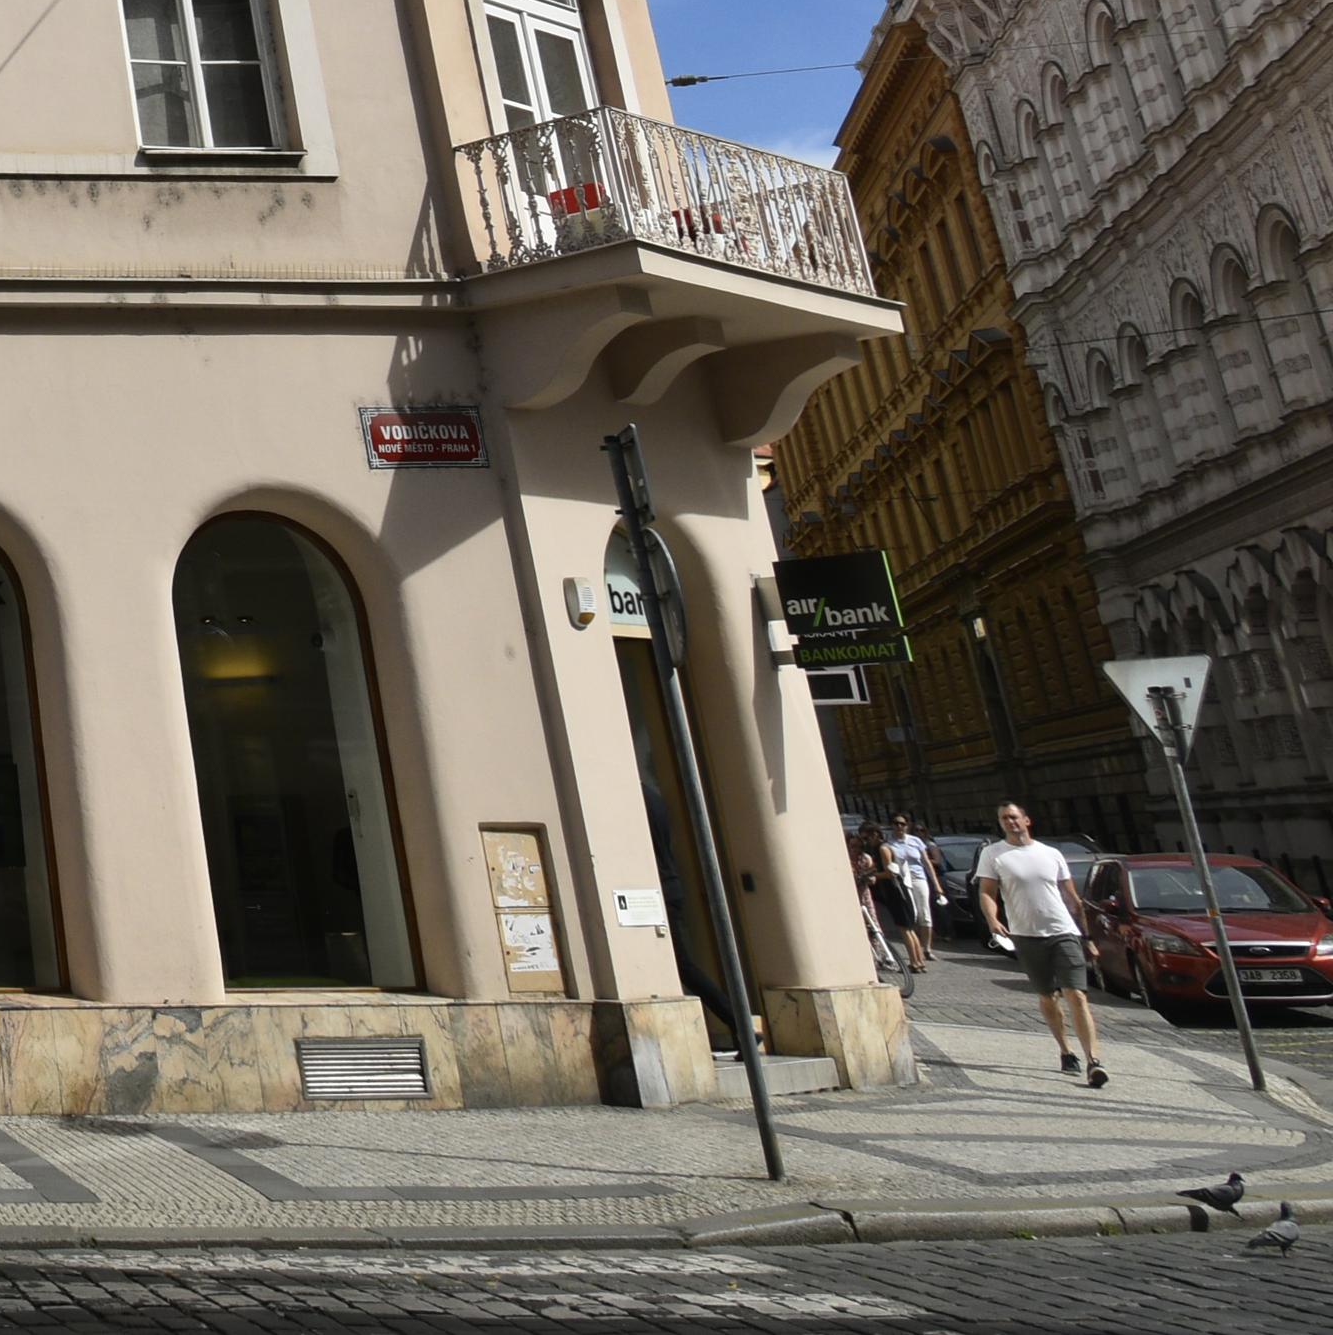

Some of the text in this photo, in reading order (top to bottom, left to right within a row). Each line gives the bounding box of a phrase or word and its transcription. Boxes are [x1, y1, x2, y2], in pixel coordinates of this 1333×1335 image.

[380, 421, 470, 441] VODIČKOVA
[378, 443, 403, 454] NOVÉ
[405, 442, 434, 453] MĚSTO
[441, 444, 470, 453] PRAHA
[824, 601, 891, 627] bank
[799, 642, 897, 663] BANKOMAT
